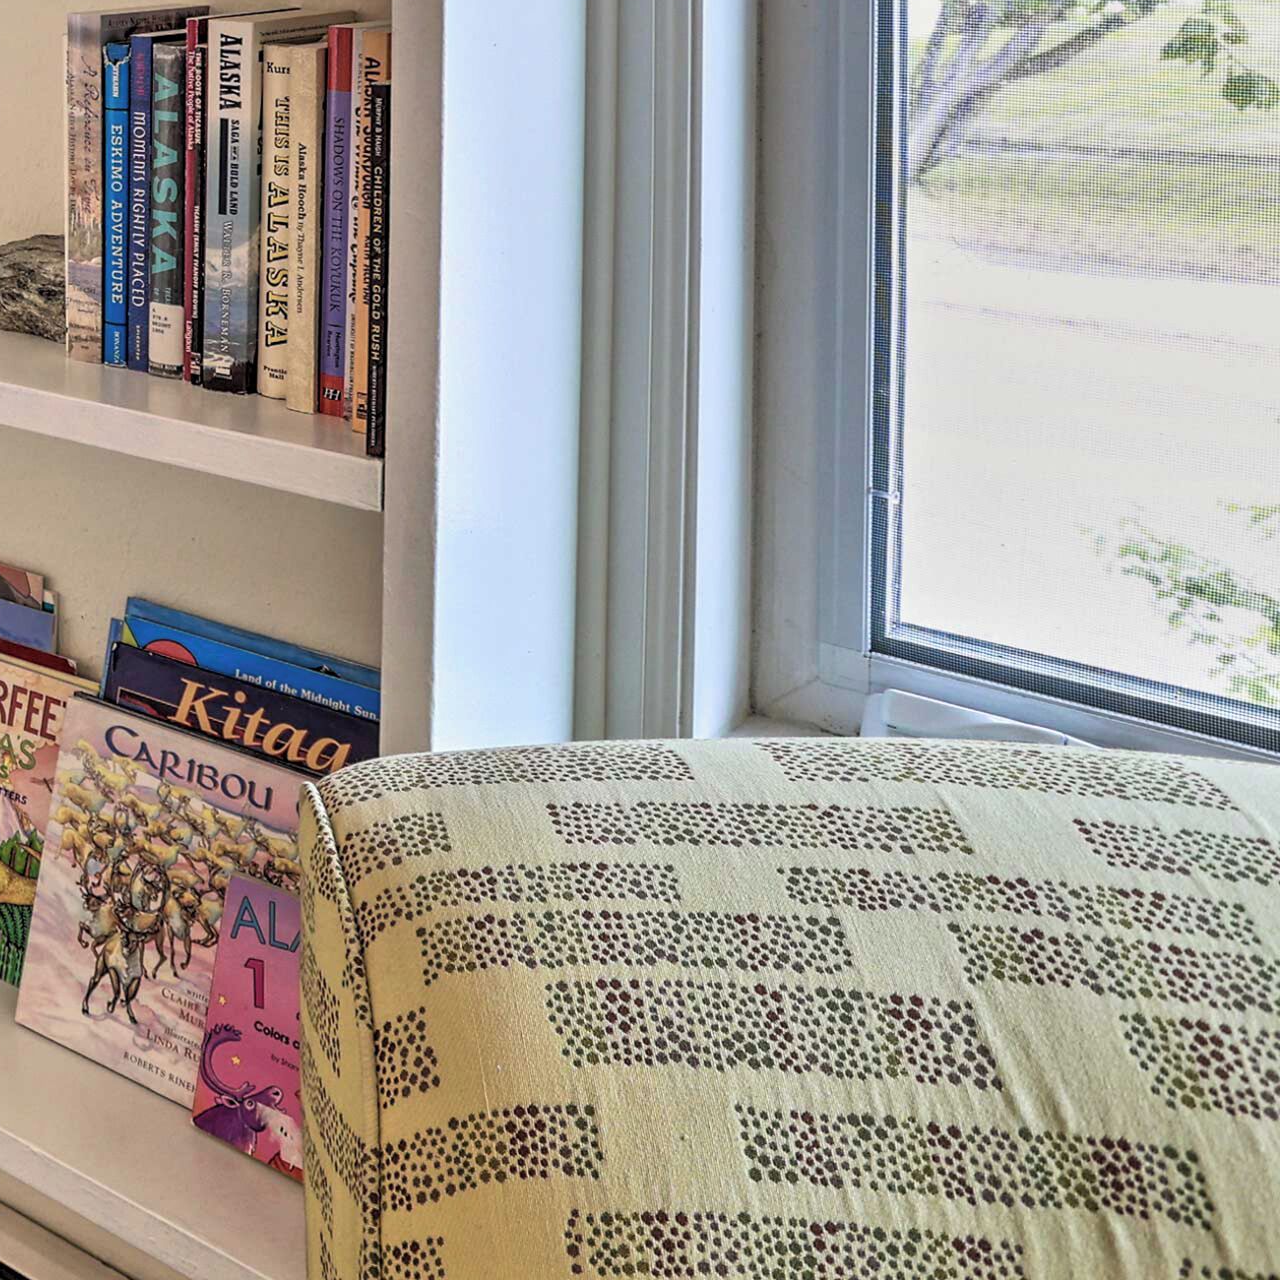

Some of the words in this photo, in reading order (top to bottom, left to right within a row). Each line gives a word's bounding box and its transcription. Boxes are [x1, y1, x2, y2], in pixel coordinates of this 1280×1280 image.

[187, 66, 195, 90] Native
[219, 33, 243, 111] ALASKA
[186, 91, 195, 115] People
[195, 98, 202, 108] OF
[375, 97, 383, 125] MURPHY
[231, 119, 240, 145] SAGA
[274, 96, 290, 149] THIS
[111, 124, 123, 192] ESKIMO
[133, 111, 146, 184] MOMENTS
[297, 143, 307, 180] Alaska
[333, 116, 345, 186] SHADOWS
[374, 137, 382, 157] HAIGH
[151, 72, 179, 275] ALASKA
[230, 162, 239, 189] BOLD
[273, 154, 289, 176] IS
[229, 190, 239, 216] LAND
[297, 183, 307, 220] Hooch
[332, 190, 344, 211] ON
[373, 166, 383, 232] CHILDREN
[132, 188, 146, 248] RIGHTLY
[331, 216, 343, 240] THE
[111, 199, 124, 305] ADVENTURE
[222, 221, 234, 267] WALTER
[295, 232, 305, 264] Thayne
[372, 238, 382, 253] OF
[131, 252, 145, 308] PLACED
[265, 181, 290, 348] ALASKA
[328, 246, 342, 313] KOYUKUK
[372, 258, 382, 280] THE
[371, 285, 381, 320] GOLD
[219, 288, 232, 353] BORNEMAN
[371, 324, 381, 361] RUSH
[234, 668, 262, 686] Land
[265, 677, 278, 691] of
[280, 681, 298, 696] the
[300, 687, 351, 714] Midnight
[104, 725, 274, 812] CARIBOU
[161, 987, 200, 1011] CLAIRE
[186, 989, 208, 1003] writte
[244, 957, 265, 1010] 1
[179, 1007, 204, 1029] MUR
[253, 1020, 290, 1046] Colors
[146, 1028, 180, 1055] LINDA
[123, 1051, 167, 1078] ROBERTS
